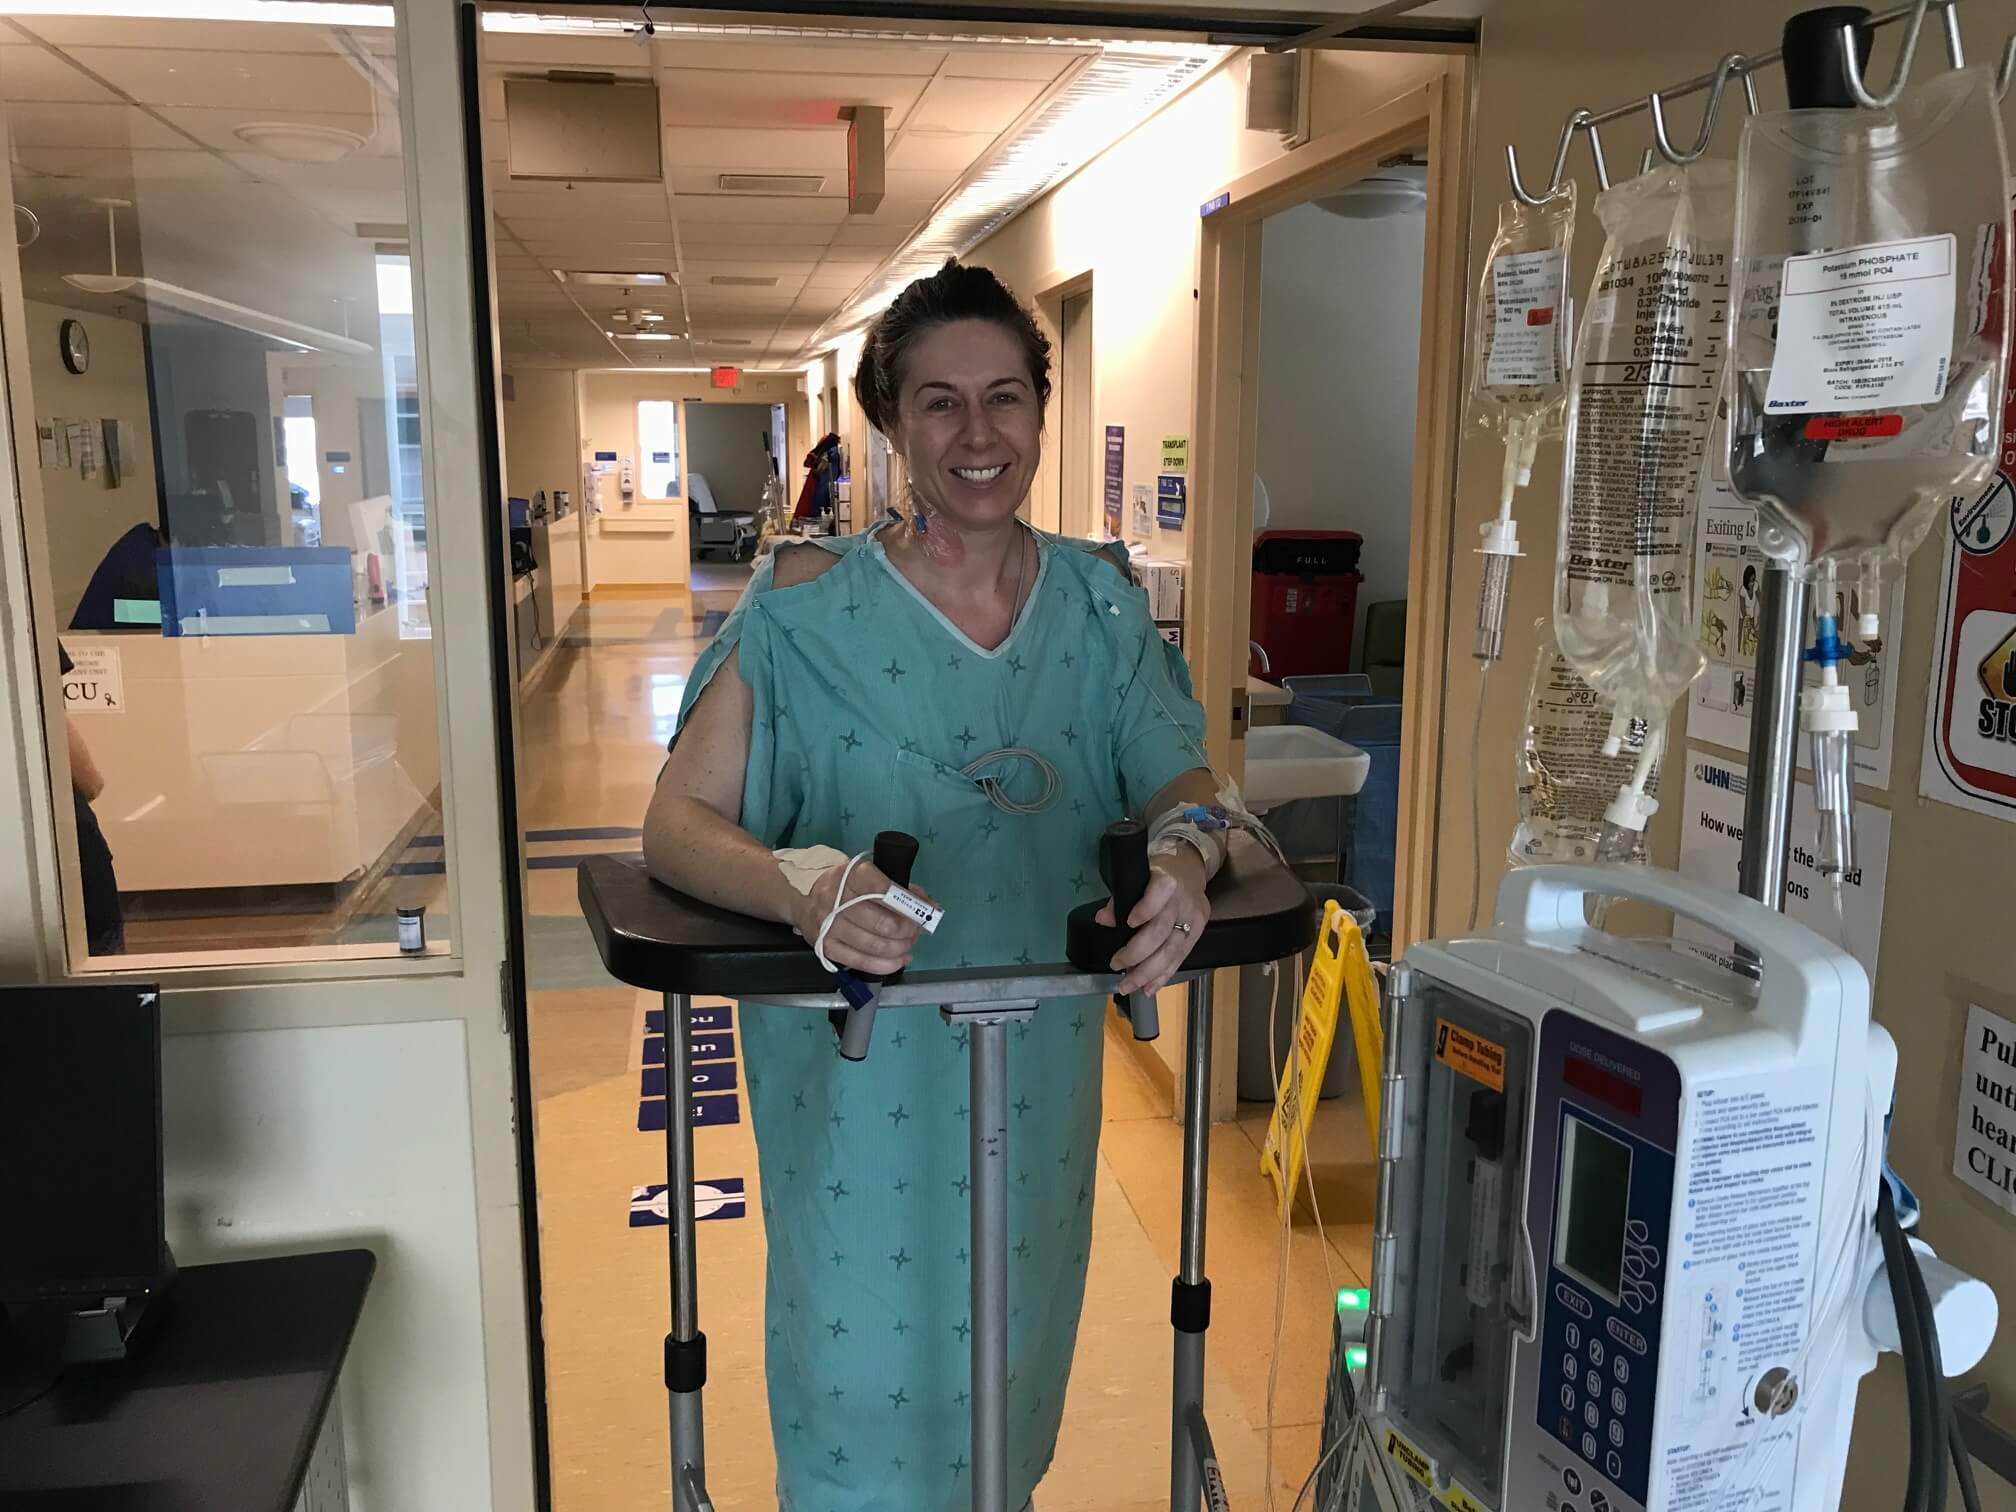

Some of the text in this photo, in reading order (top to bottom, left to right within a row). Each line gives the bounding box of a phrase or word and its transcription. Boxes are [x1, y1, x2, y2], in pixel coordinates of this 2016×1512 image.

[1858, 252, 1920, 267] PHOSPHATE
[1849, 269, 1871, 279] mmol
[1874, 266, 1893, 275] PO4
[1848, 305, 1875, 314] VOLUME
[1839, 313, 1887, 324] INTRAVENOUS
[1768, 400, 1808, 408] Baxter
[1853, 416, 1885, 426] ALERT
[1162, 440, 1186, 449] TRANSPLANT
[1173, 457, 1184, 466] DOWN
[1706, 518, 1744, 541] Exiting
[1296, 556, 1327, 565] FULL
[1570, 554, 1632, 570] Baxter
[1703, 764, 1731, 790] UHN
[1700, 811, 1725, 834] How
[1793, 847, 1814, 868] the
[1451, 1028, 1502, 1066] Clamp Tubing
[1569, 1040, 1641, 1081] DOSE DELIVERED
[1562, 1289, 1586, 1313] EXIT
[1609, 1321, 1644, 1351] ENTER
[1395, 1439, 1430, 1471] UNCLAMP
[1399, 1450, 1425, 1477] TUBING
